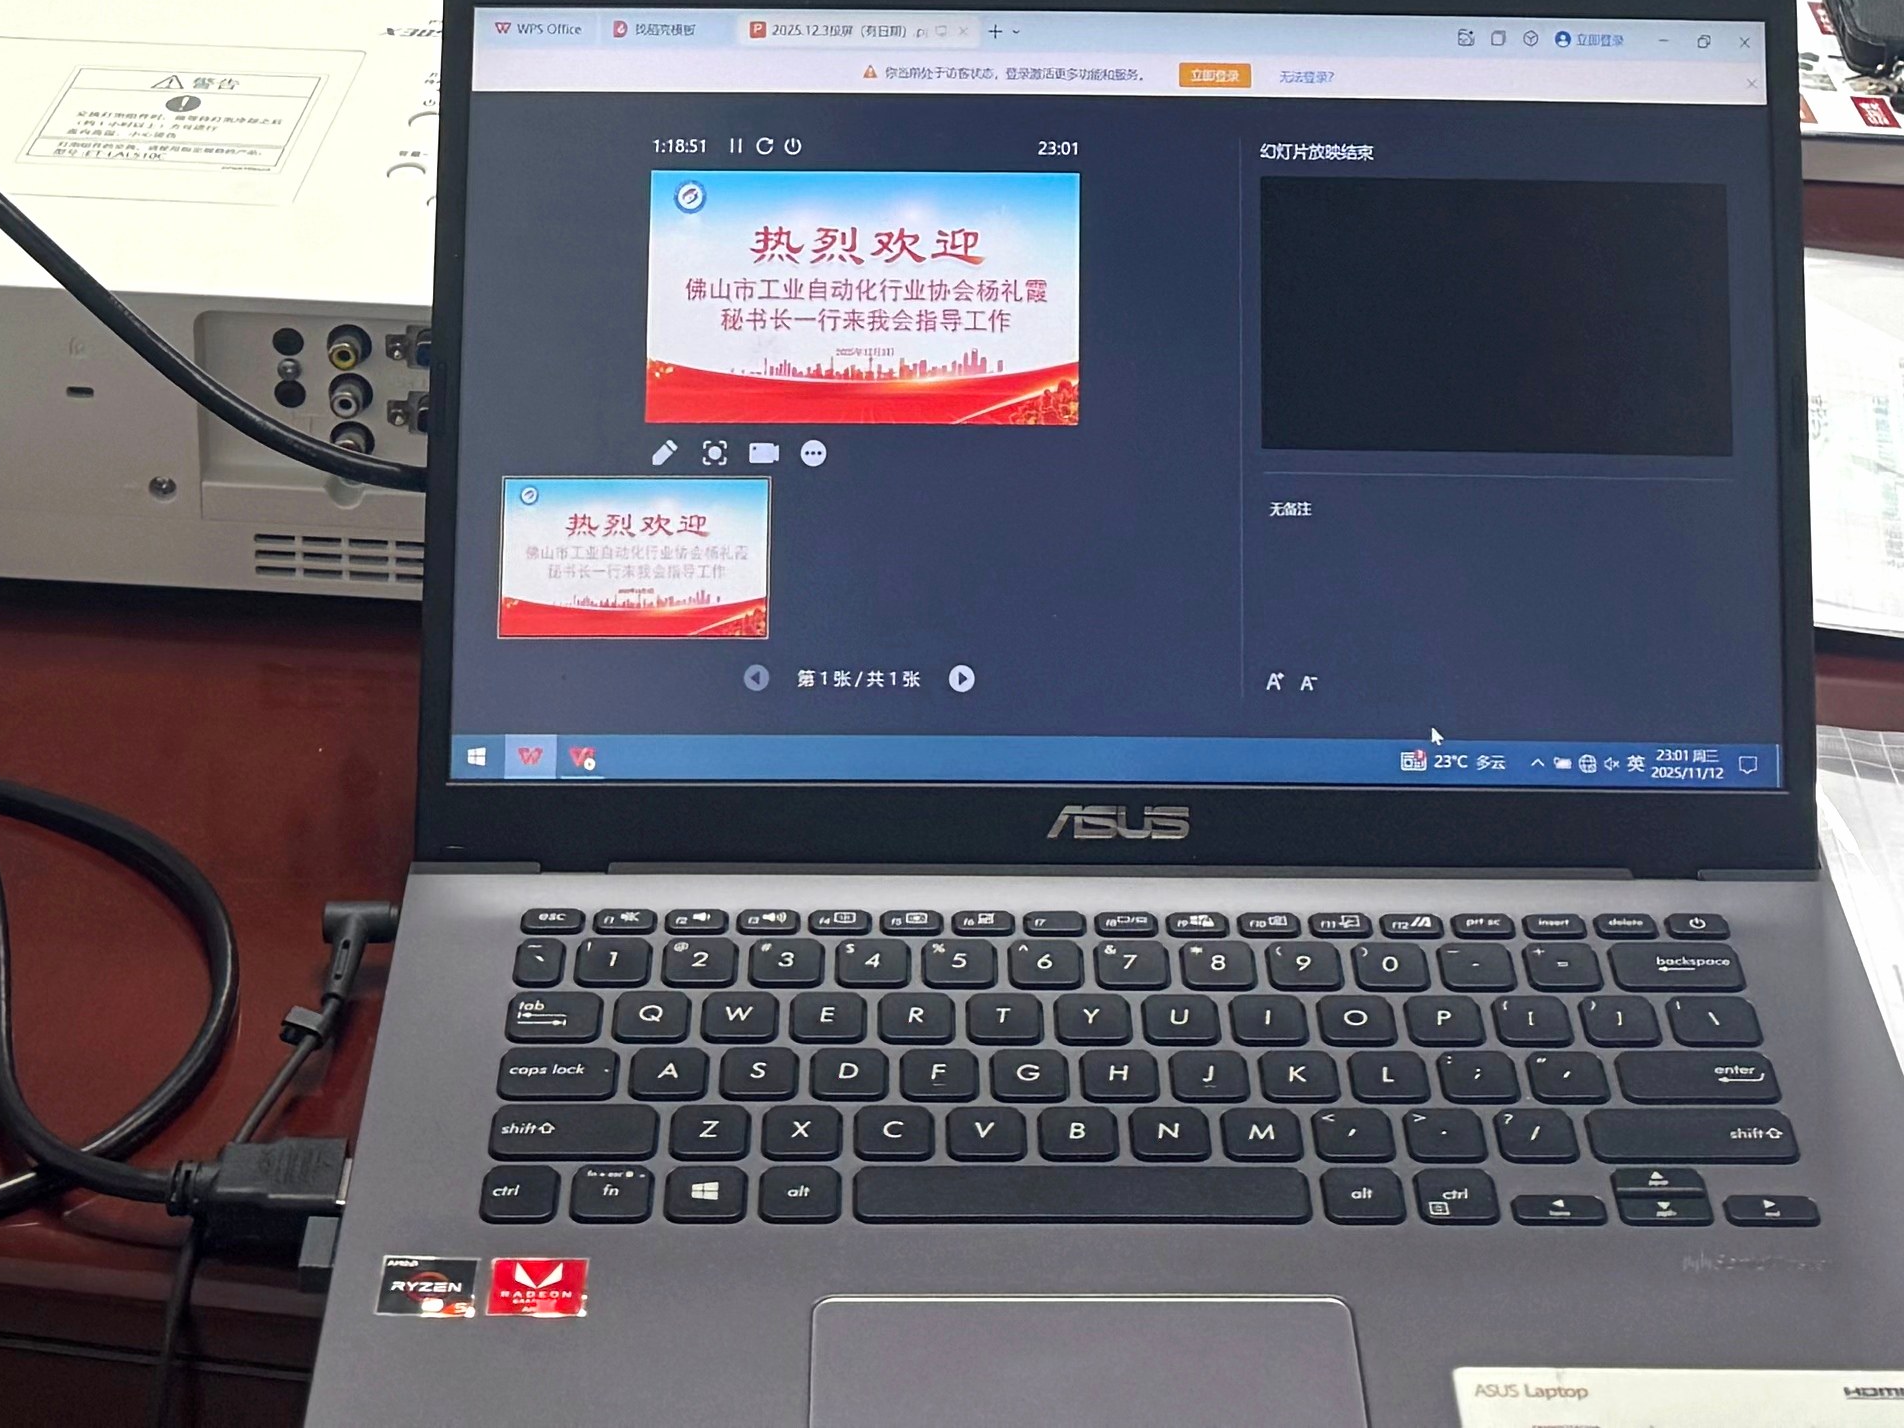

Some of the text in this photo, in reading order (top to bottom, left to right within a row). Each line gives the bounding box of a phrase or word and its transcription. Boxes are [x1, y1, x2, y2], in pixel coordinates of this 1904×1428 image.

[517, 21, 583, 35] WPS Office
[1576, 33, 1625, 48] 立即登录
[192, 76, 240, 90] 警告
[1191, 69, 1240, 84] 立即登录
[653, 139, 707, 154] 1:18:51
[1038, 141, 1079, 156] 23:01
[1260, 143, 1375, 162] 幻灯片放映结束
[750, 225, 986, 266] 热烈欢迎
[685, 278, 1048, 304] 佛山市工业自动化行业协会杨礼霞
[720, 307, 1012, 333] 秘书长一行来我会指导工作
[1269, 502, 1312, 518] 无备注
[565, 513, 710, 538] 热烈欢迎
[1476, 755, 1506, 771] 多云
[1627, 754, 1645, 773] 英
[1656, 748, 1720, 763] 23:01 周三
[1651, 764, 1724, 781] 2025/11/12
[1046, 804, 1190, 840] ASUS
[538, 912, 567, 921] esc
[1537, 918, 1570, 927] insert
[1608, 918, 1644, 927] delete
[609, 951, 618, 967] 1
[691, 951, 709, 967] 2
[777, 951, 795, 967] 3
[864, 953, 880, 968] 4
[951, 952, 967, 969] 5
[1036, 953, 1053, 970] 6
[1123, 954, 1138, 970] 7
[1210, 954, 1226, 971] 8
[1296, 955, 1312, 971] 9
[1382, 956, 1399, 972] 0
[1656, 955, 1731, 968] backspace
[518, 999, 544, 1011] tab
[638, 1004, 663, 1022] Q
[725, 1006, 754, 1021] W
[820, 1006, 836, 1023] E
[908, 1006, 924, 1023] R
[996, 1007, 1011, 1024] T
[1083, 1008, 1100, 1024] Y
[1170, 1008, 1189, 1025] U
[1343, 1009, 1368, 1026] O
[1437, 1010, 1452, 1026] P
[509, 1062, 585, 1078] caps lock
[657, 1062, 679, 1079] A
[750, 1062, 767, 1079] S
[838, 1062, 859, 1079] D
[931, 1063, 947, 1080] F
[1016, 1063, 1040, 1082] G
[1108, 1064, 1129, 1081] H
[1202, 1065, 1214, 1083] J
[1288, 1065, 1307, 1083] K
[1382, 1066, 1395, 1083] L
[1714, 1064, 1756, 1078] enter
[501, 1121, 537, 1135] shift
[699, 1120, 720, 1138] Z
[791, 1120, 811, 1138] X
[882, 1120, 904, 1139] C
[974, 1121, 995, 1139] V
[1069, 1122, 1086, 1140] B
[1158, 1122, 1180, 1139] N
[1248, 1124, 1275, 1140] M
[1729, 1127, 1765, 1139] shift
[493, 1183, 520, 1198] ctrl
[603, 1184, 619, 1197] fn
[787, 1185, 810, 1197] alt
[1351, 1186, 1373, 1200] alt
[1442, 1188, 1469, 1201] ctrl
[391, 1281, 463, 1293] RYZEN
[500, 1290, 573, 1299] RADEON
[1474, 1383, 1589, 1401] ASUS Laptop
